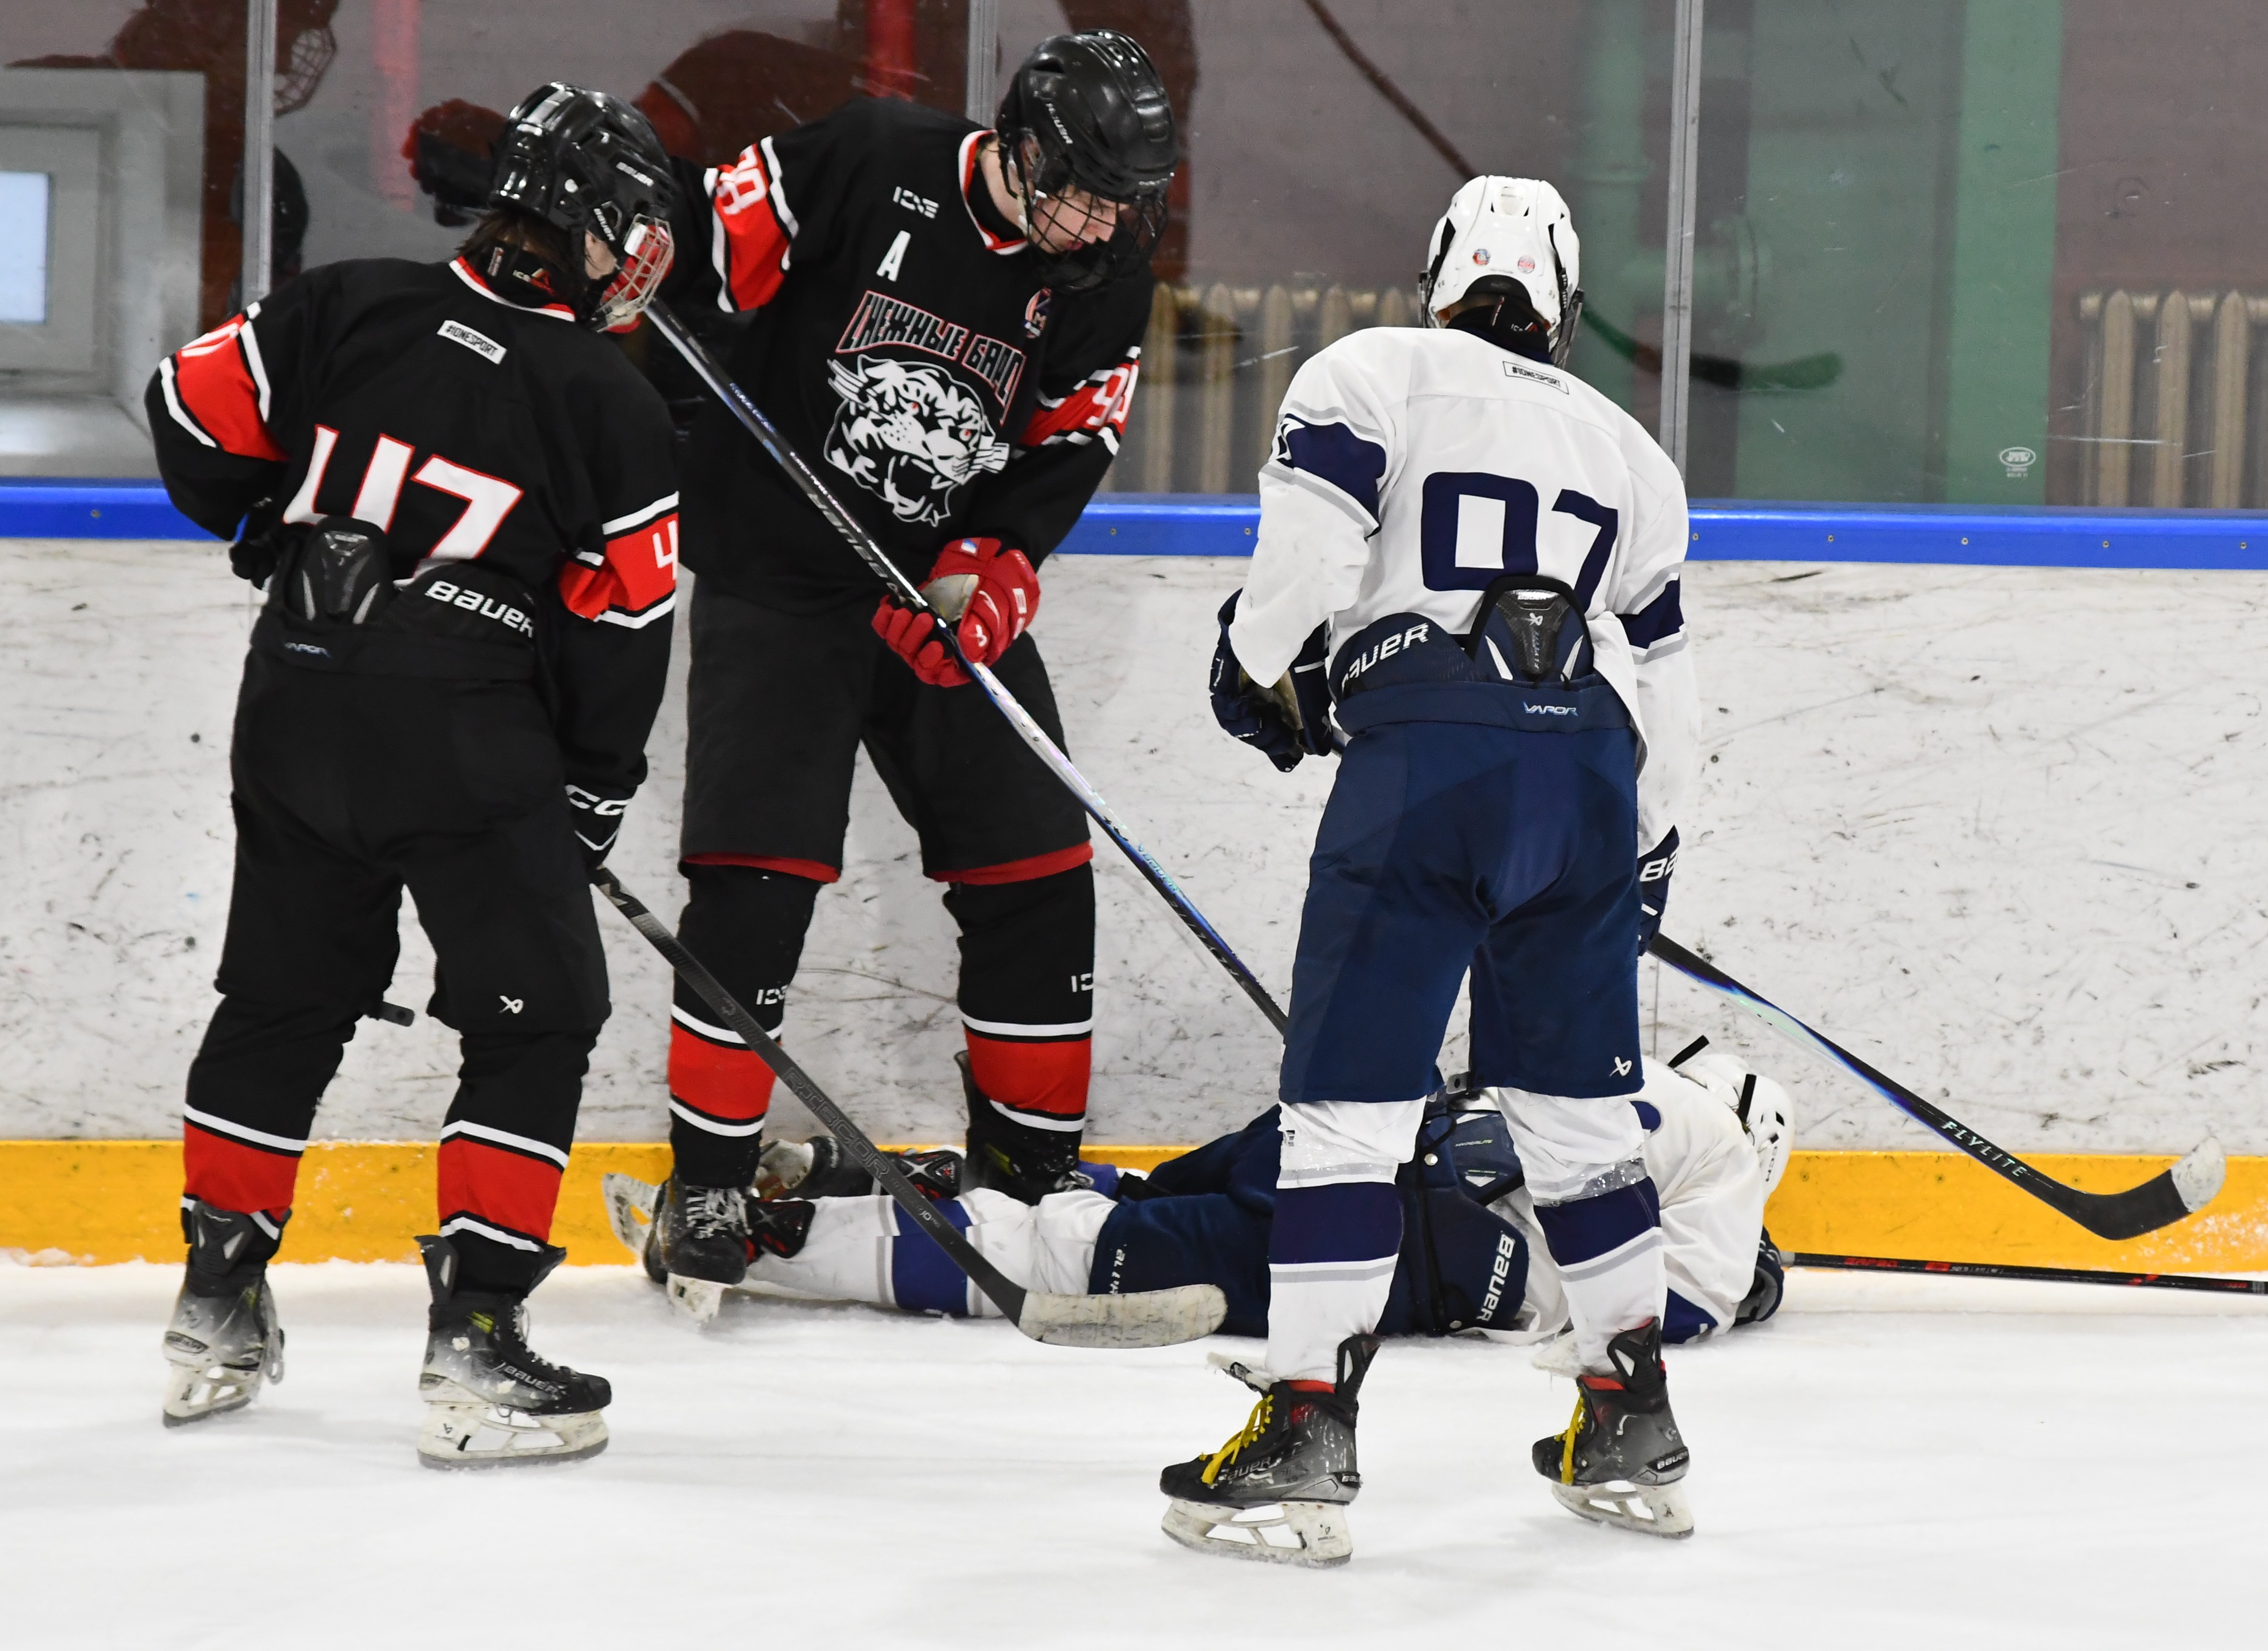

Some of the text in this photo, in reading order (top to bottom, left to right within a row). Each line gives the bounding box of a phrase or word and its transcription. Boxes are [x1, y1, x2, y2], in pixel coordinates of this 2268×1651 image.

[615, 161, 655, 188] BAUER
[876, 230, 911, 282] A
[283, 424, 525, 586] 47
[424, 580, 534, 638] BAUER
[1523, 700, 1579, 717] VAPOR
[784, 1067, 890, 1178] RIBCOR
[1940, 1121, 2028, 1177] FLYLITE
[1476, 1234, 1516, 1322] BAUER
[505, 1364, 558, 1396] BAUER
[1341, 1474, 1359, 1483] BAU
